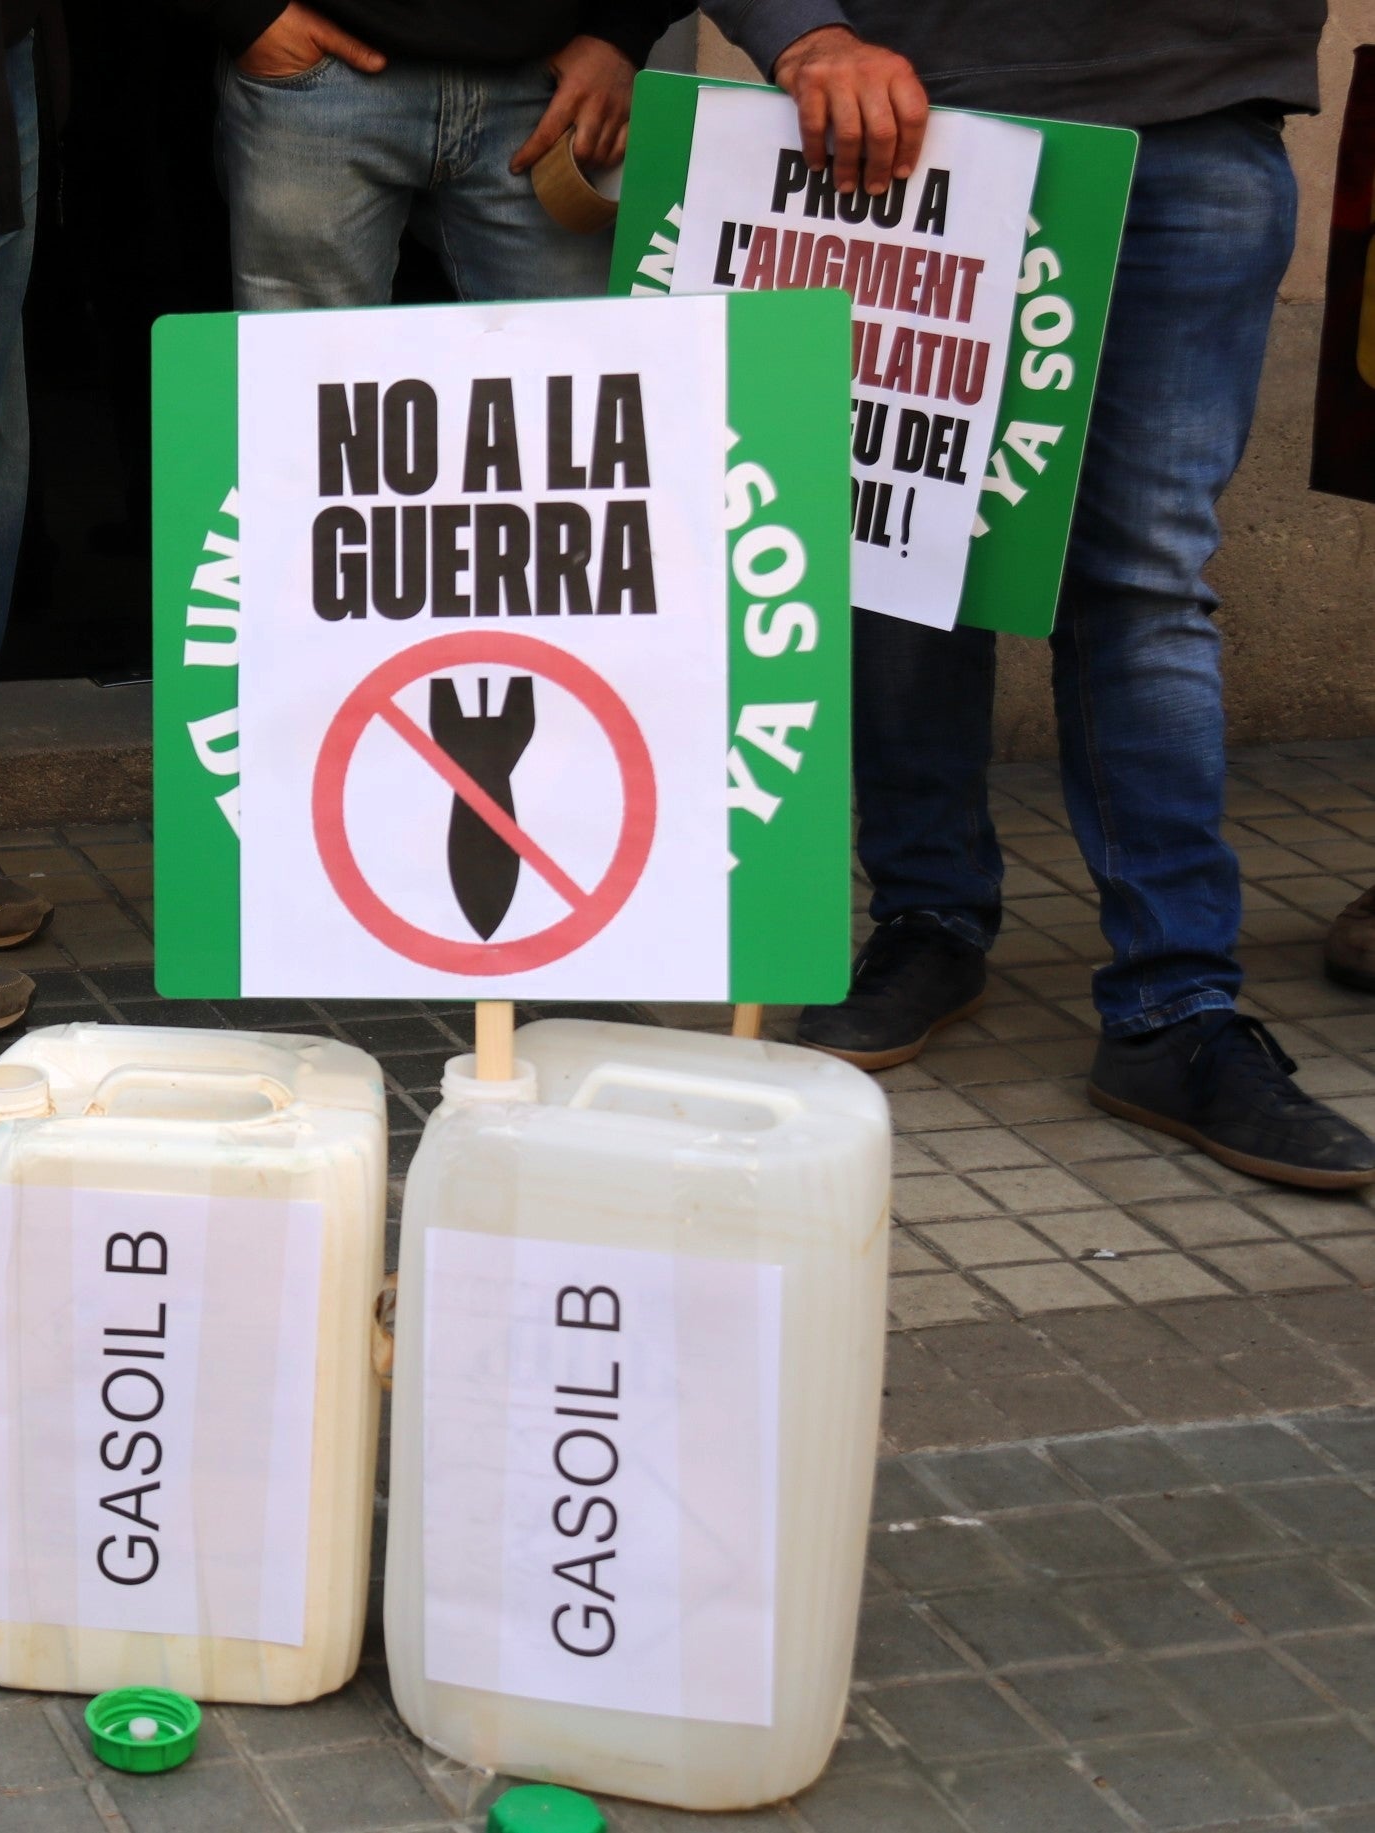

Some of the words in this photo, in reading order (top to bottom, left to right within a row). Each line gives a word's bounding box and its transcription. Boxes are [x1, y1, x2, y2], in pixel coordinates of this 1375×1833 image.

[913, 168, 950, 236] A
[319, 379, 437, 496] NO
[463, 378, 522, 492] A
[548, 374, 650, 489] LA
[893, 408, 970, 485] DEL
[313, 501, 656, 621] GUERRA
[106, 1232, 167, 1275] B
[557, 1286, 619, 1331] B
[97, 1303, 166, 1585] GASOIL
[552, 1363, 619, 1657] GASOIL
